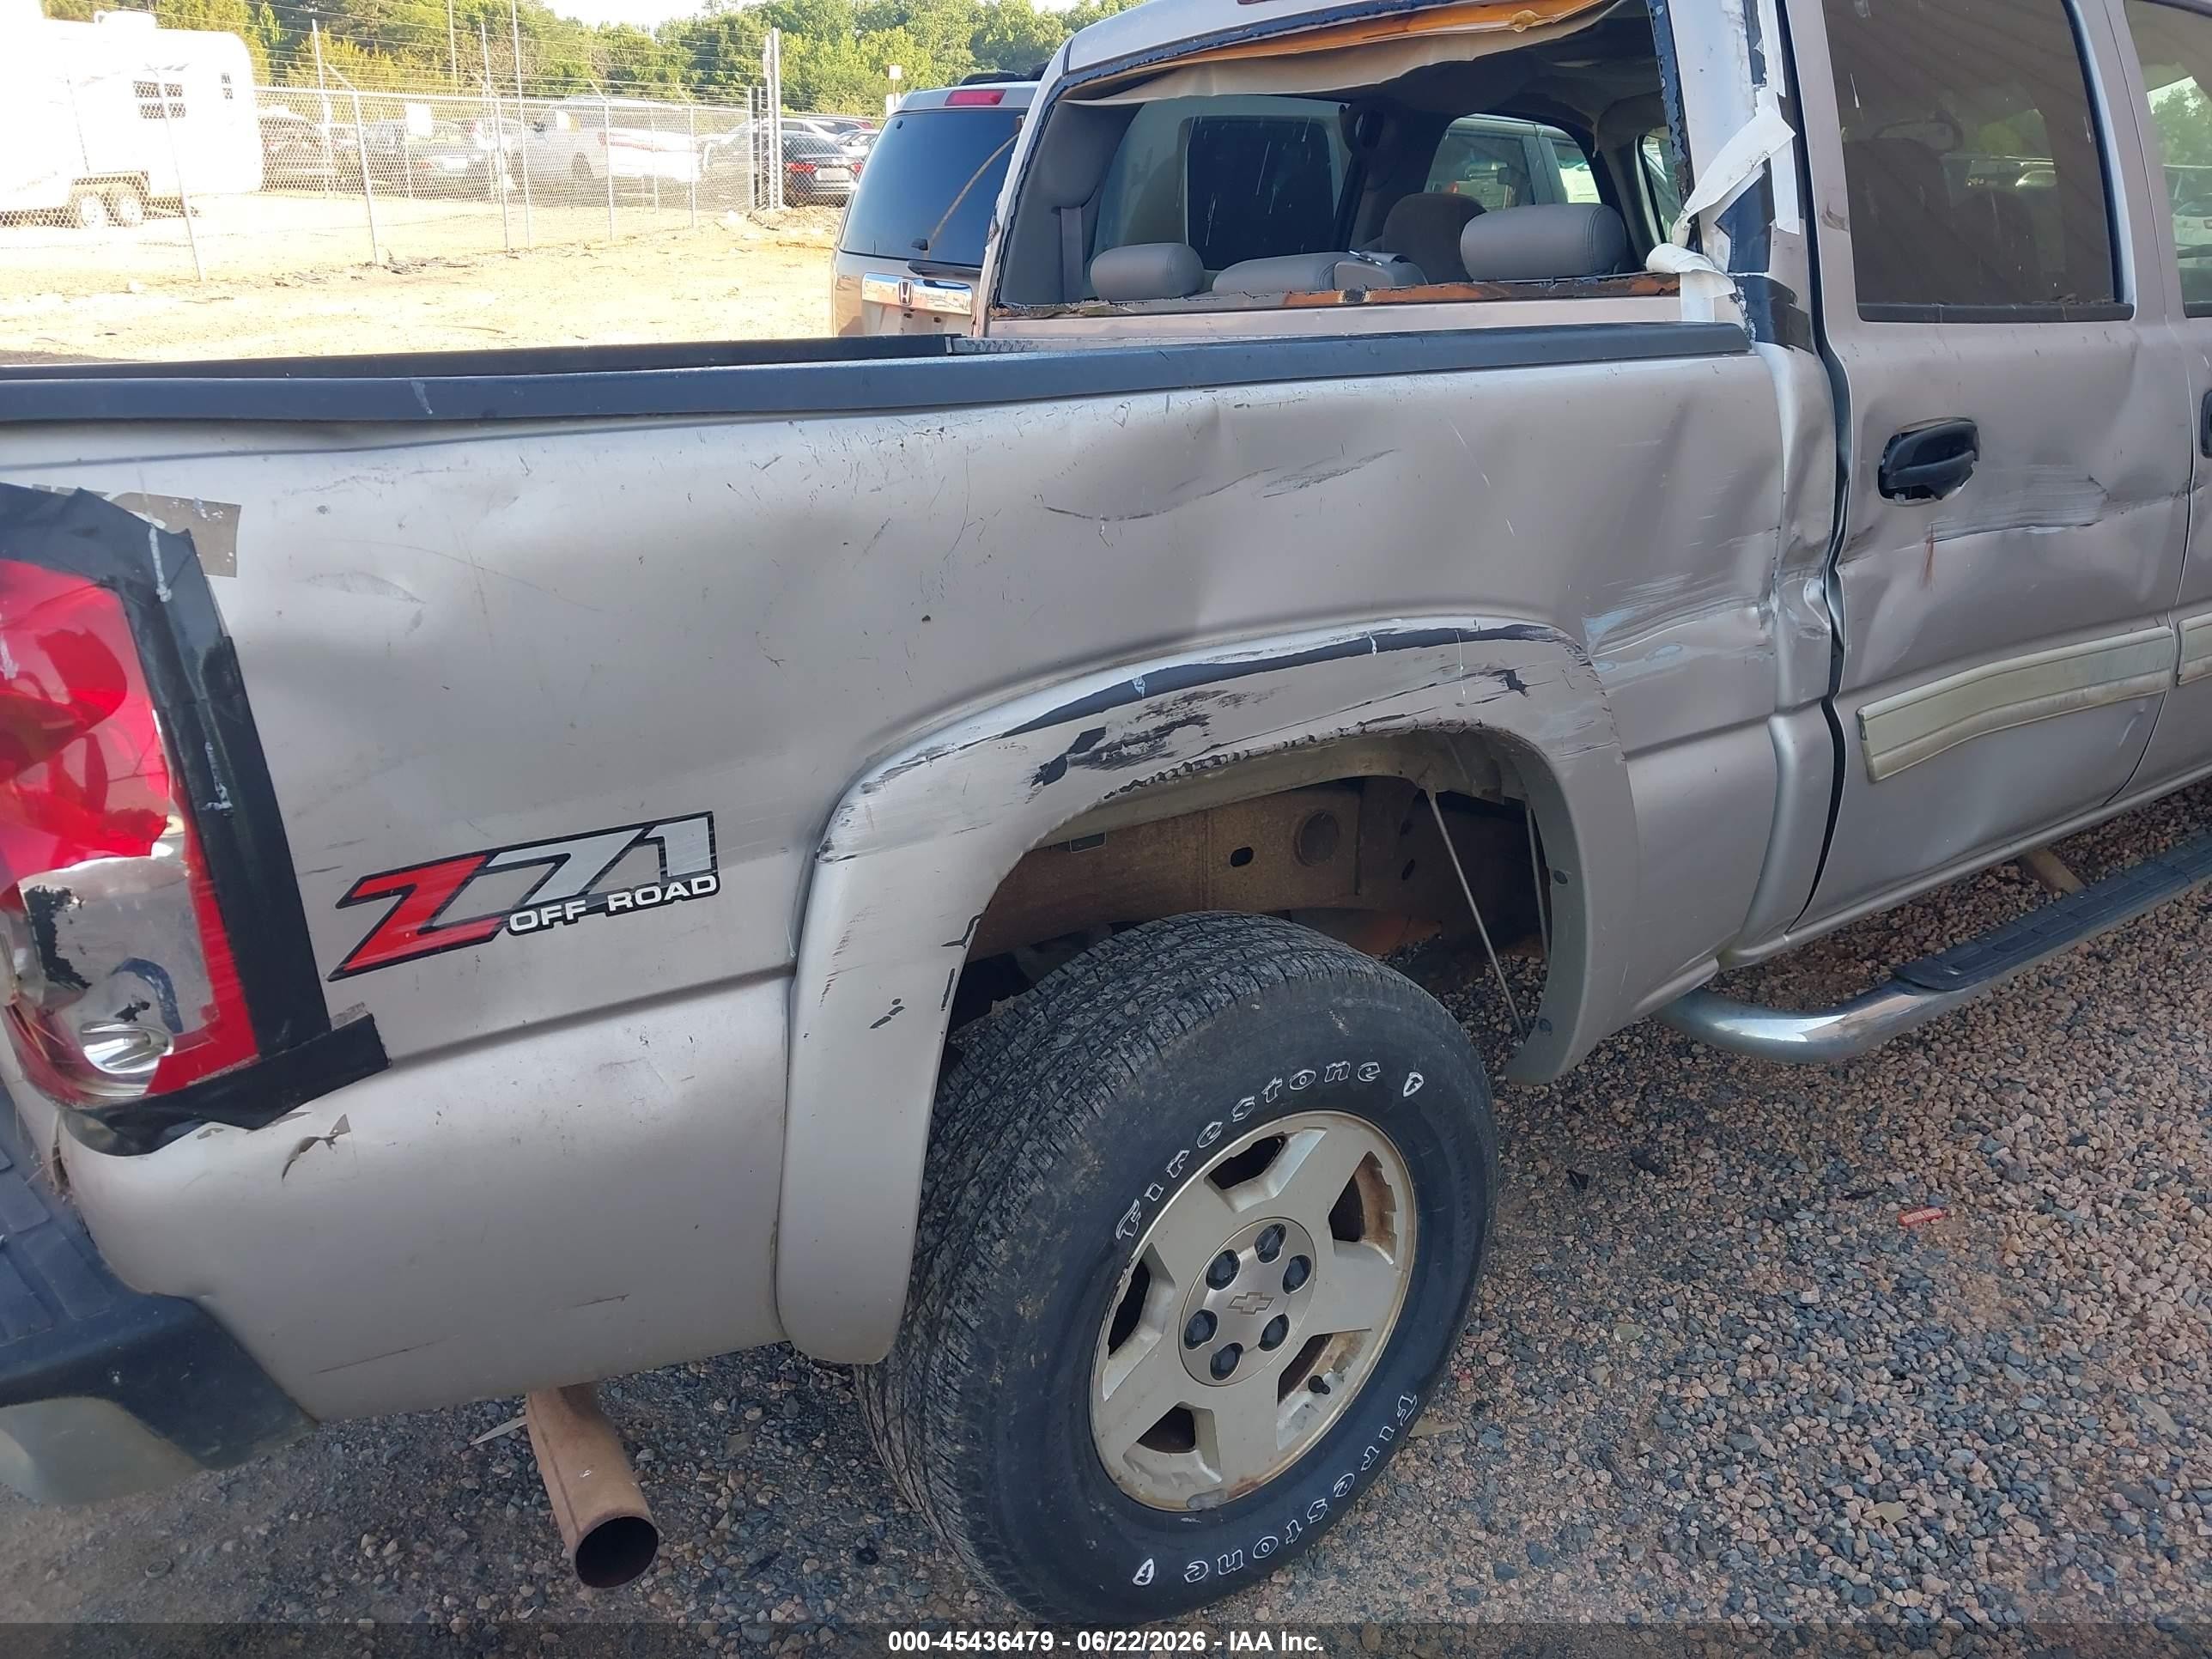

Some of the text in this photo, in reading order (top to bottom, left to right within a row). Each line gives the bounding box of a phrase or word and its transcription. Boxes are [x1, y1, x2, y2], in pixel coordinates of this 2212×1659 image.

[328, 811, 720, 981] Z71
[507, 873, 720, 933] OFF ROAD
[1115, 1060, 1382, 1242] Firestone
